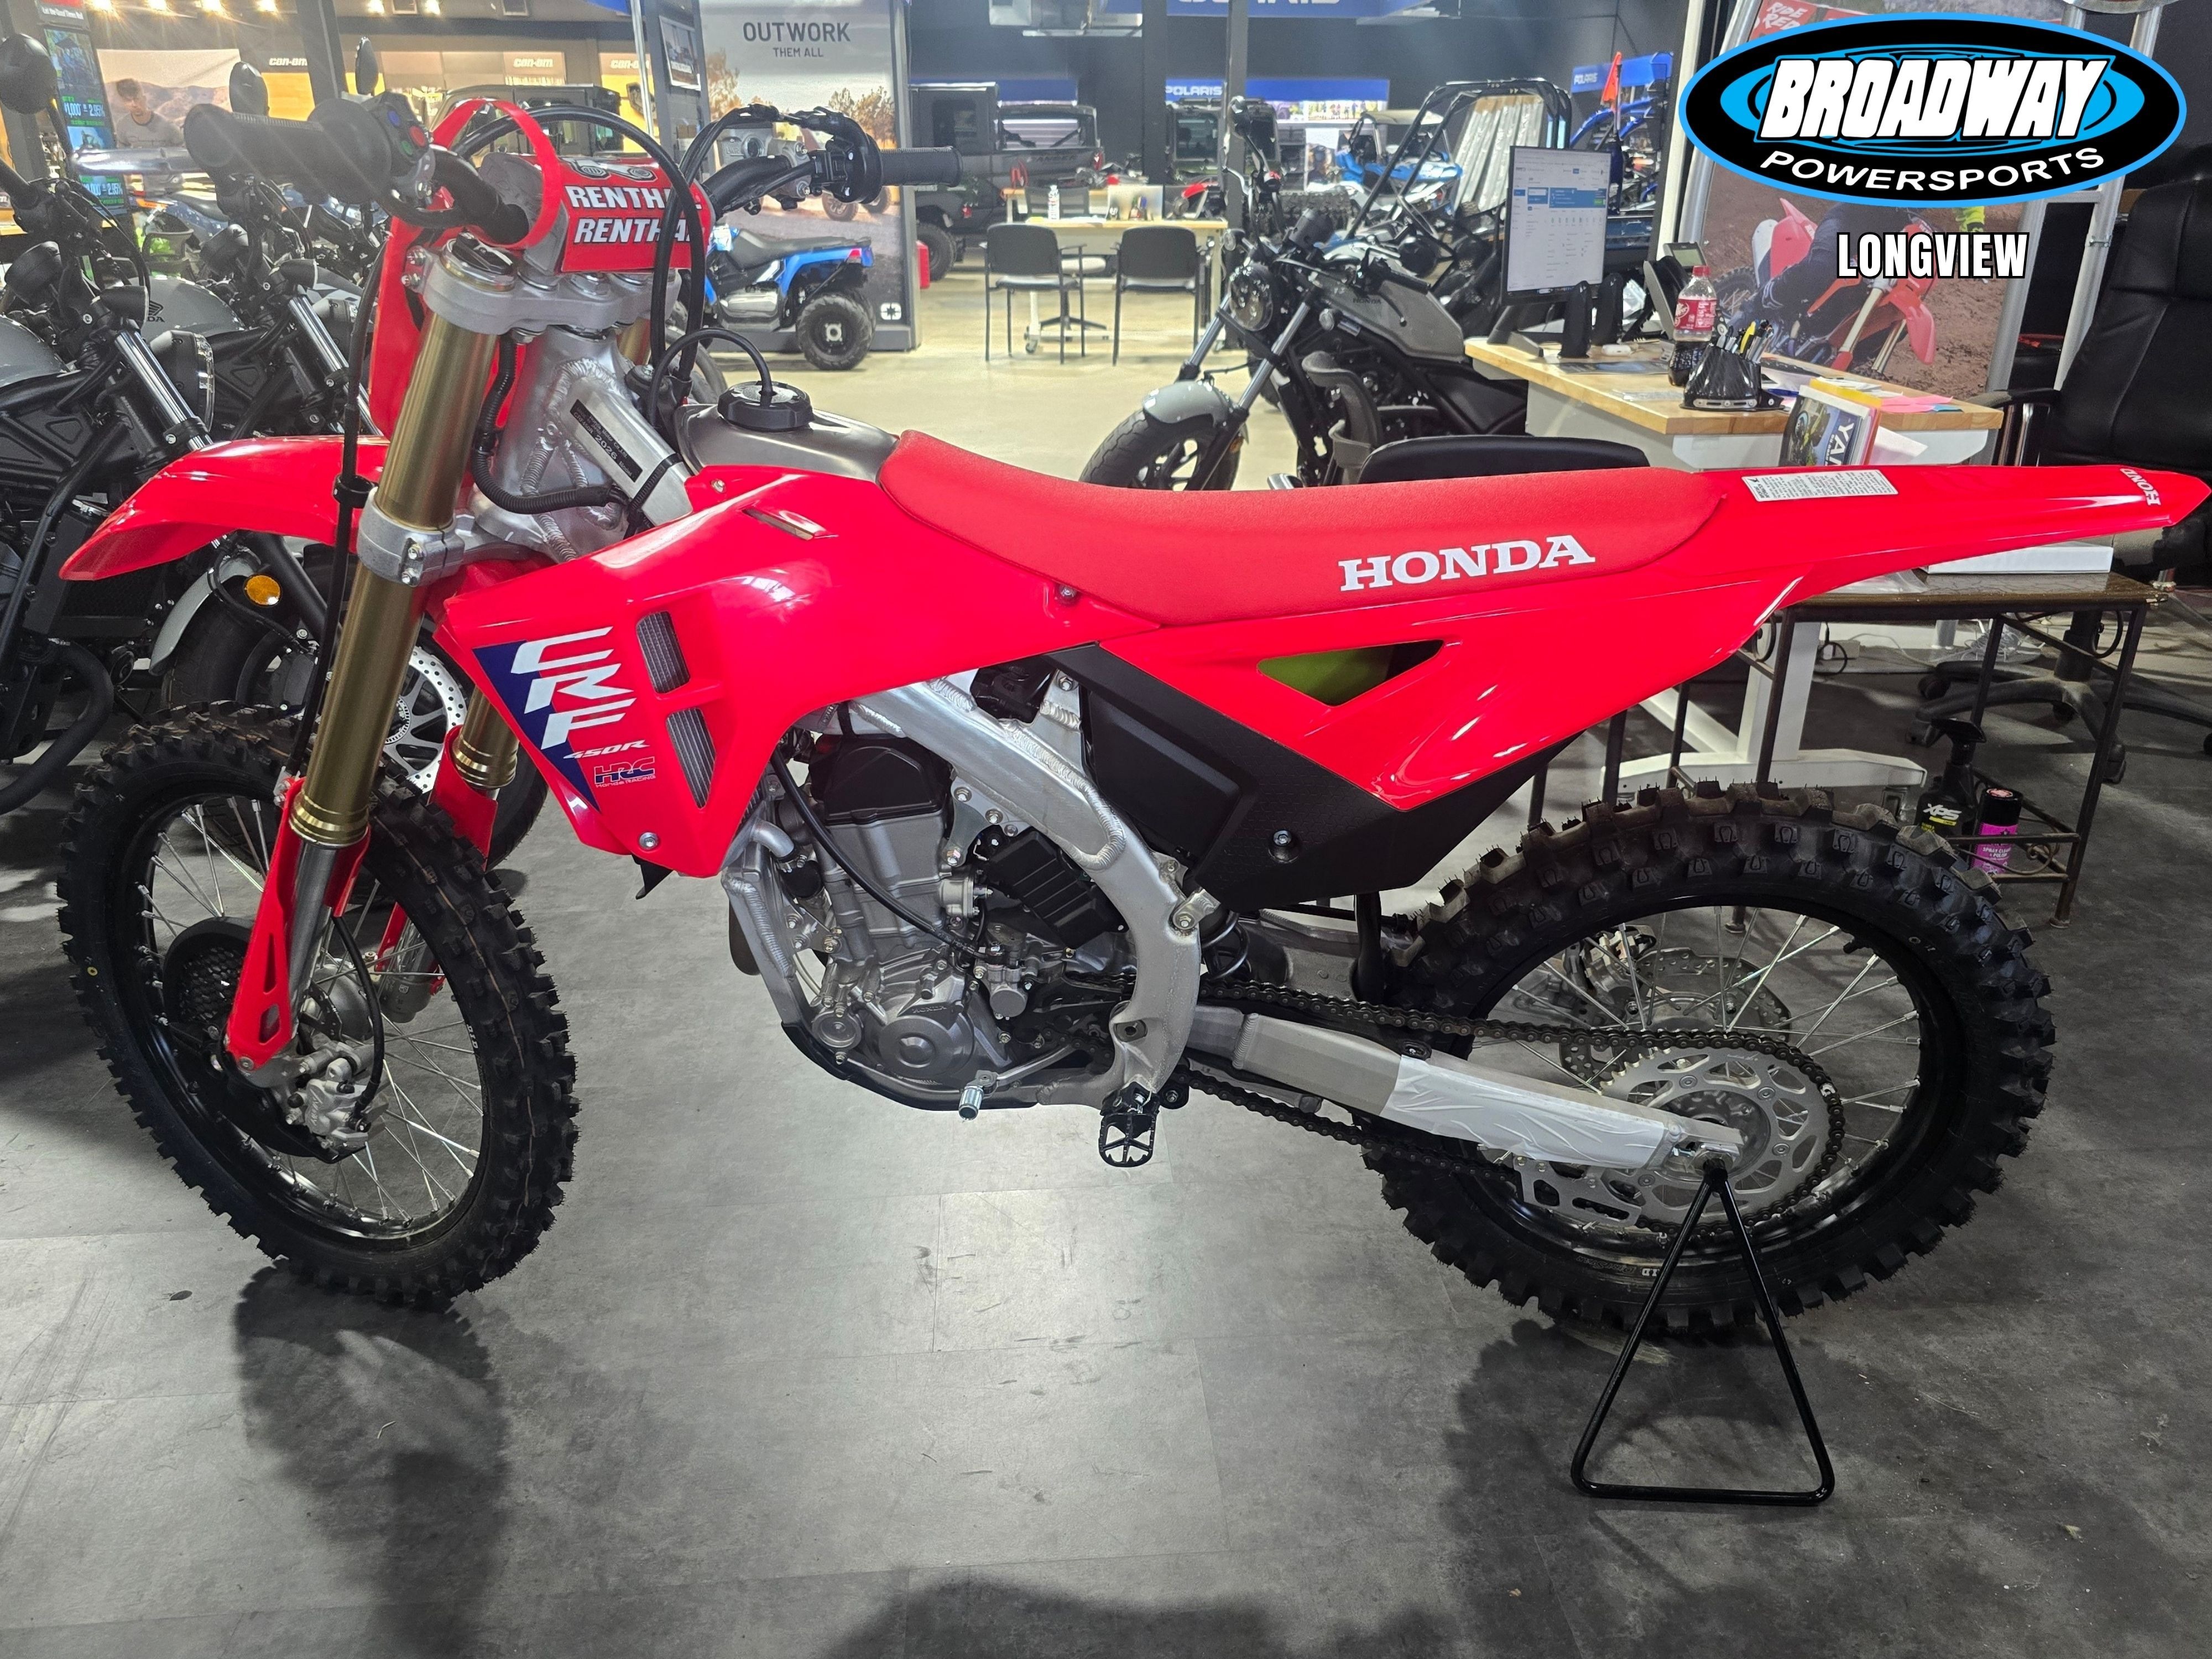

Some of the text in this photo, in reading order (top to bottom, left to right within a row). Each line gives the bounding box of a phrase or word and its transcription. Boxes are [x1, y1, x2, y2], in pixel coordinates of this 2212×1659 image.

[1766, 2, 1808, 19] RIDE
[1762, 13, 1801, 30] RED
[743, 22, 851, 42] OUTWORK
[773, 48, 824, 58] THEM ALL
[1165, 86, 1223, 96] POLARIS
[565, 185, 702, 209] RENTH
[573, 218, 691, 243] RENTHA
[588, 414, 602, 430] Honda
[573, 411, 593, 434] CRF450R
[594, 433, 618, 460] 2026
[2120, 468, 2161, 505] HOND
[1339, 535, 1595, 592] HONDA
[510, 626, 637, 750] CRF
[563, 739, 650, 759] 450R
[594, 756, 656, 785] HRC
[1923, 803, 1963, 821] XPS
